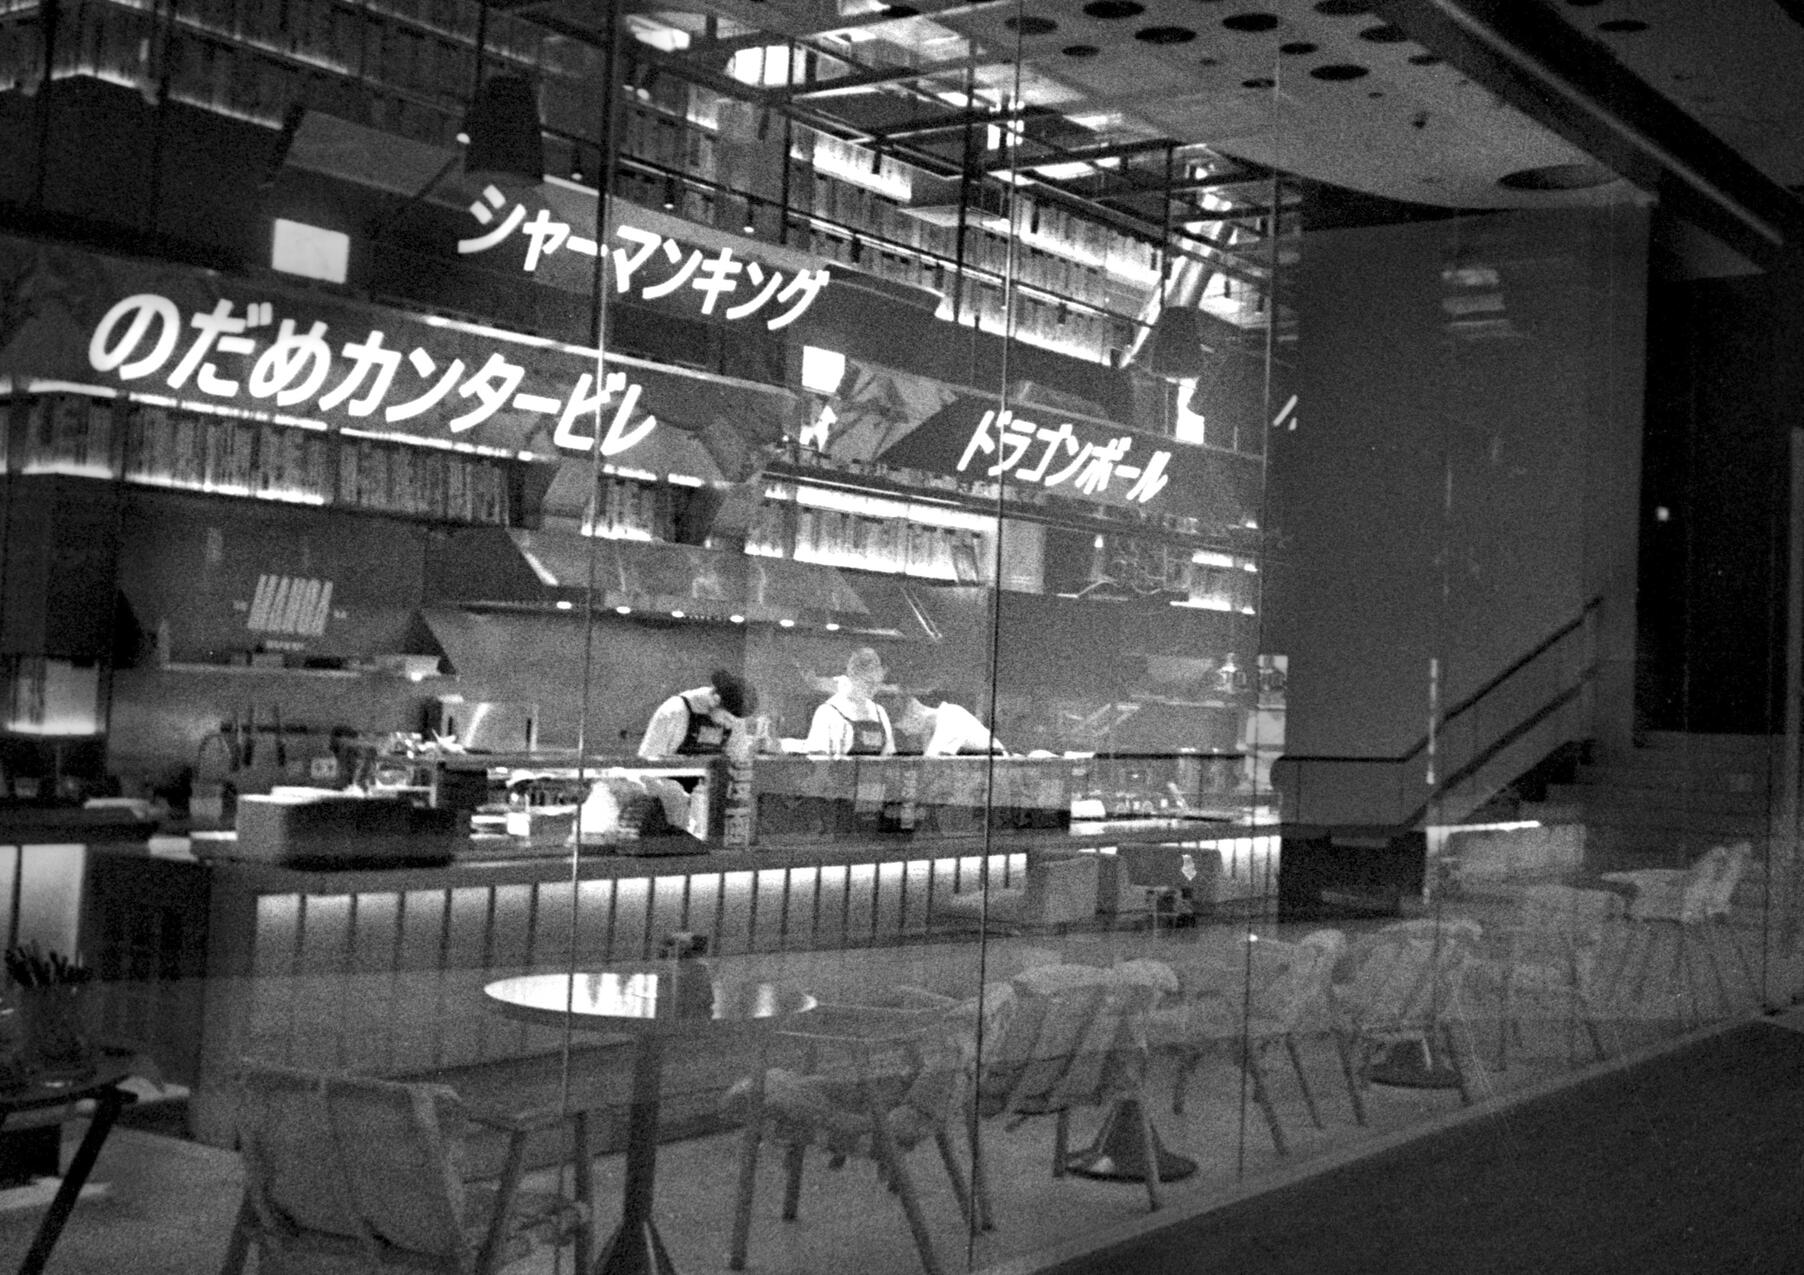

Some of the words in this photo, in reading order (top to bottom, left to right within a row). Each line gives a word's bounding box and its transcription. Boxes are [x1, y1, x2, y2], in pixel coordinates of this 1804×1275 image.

[457, 184, 831, 331] シャーマンキング
[89, 294, 657, 457] のだめカンタービレ
[956, 410, 1172, 504] ドラゴンボール
